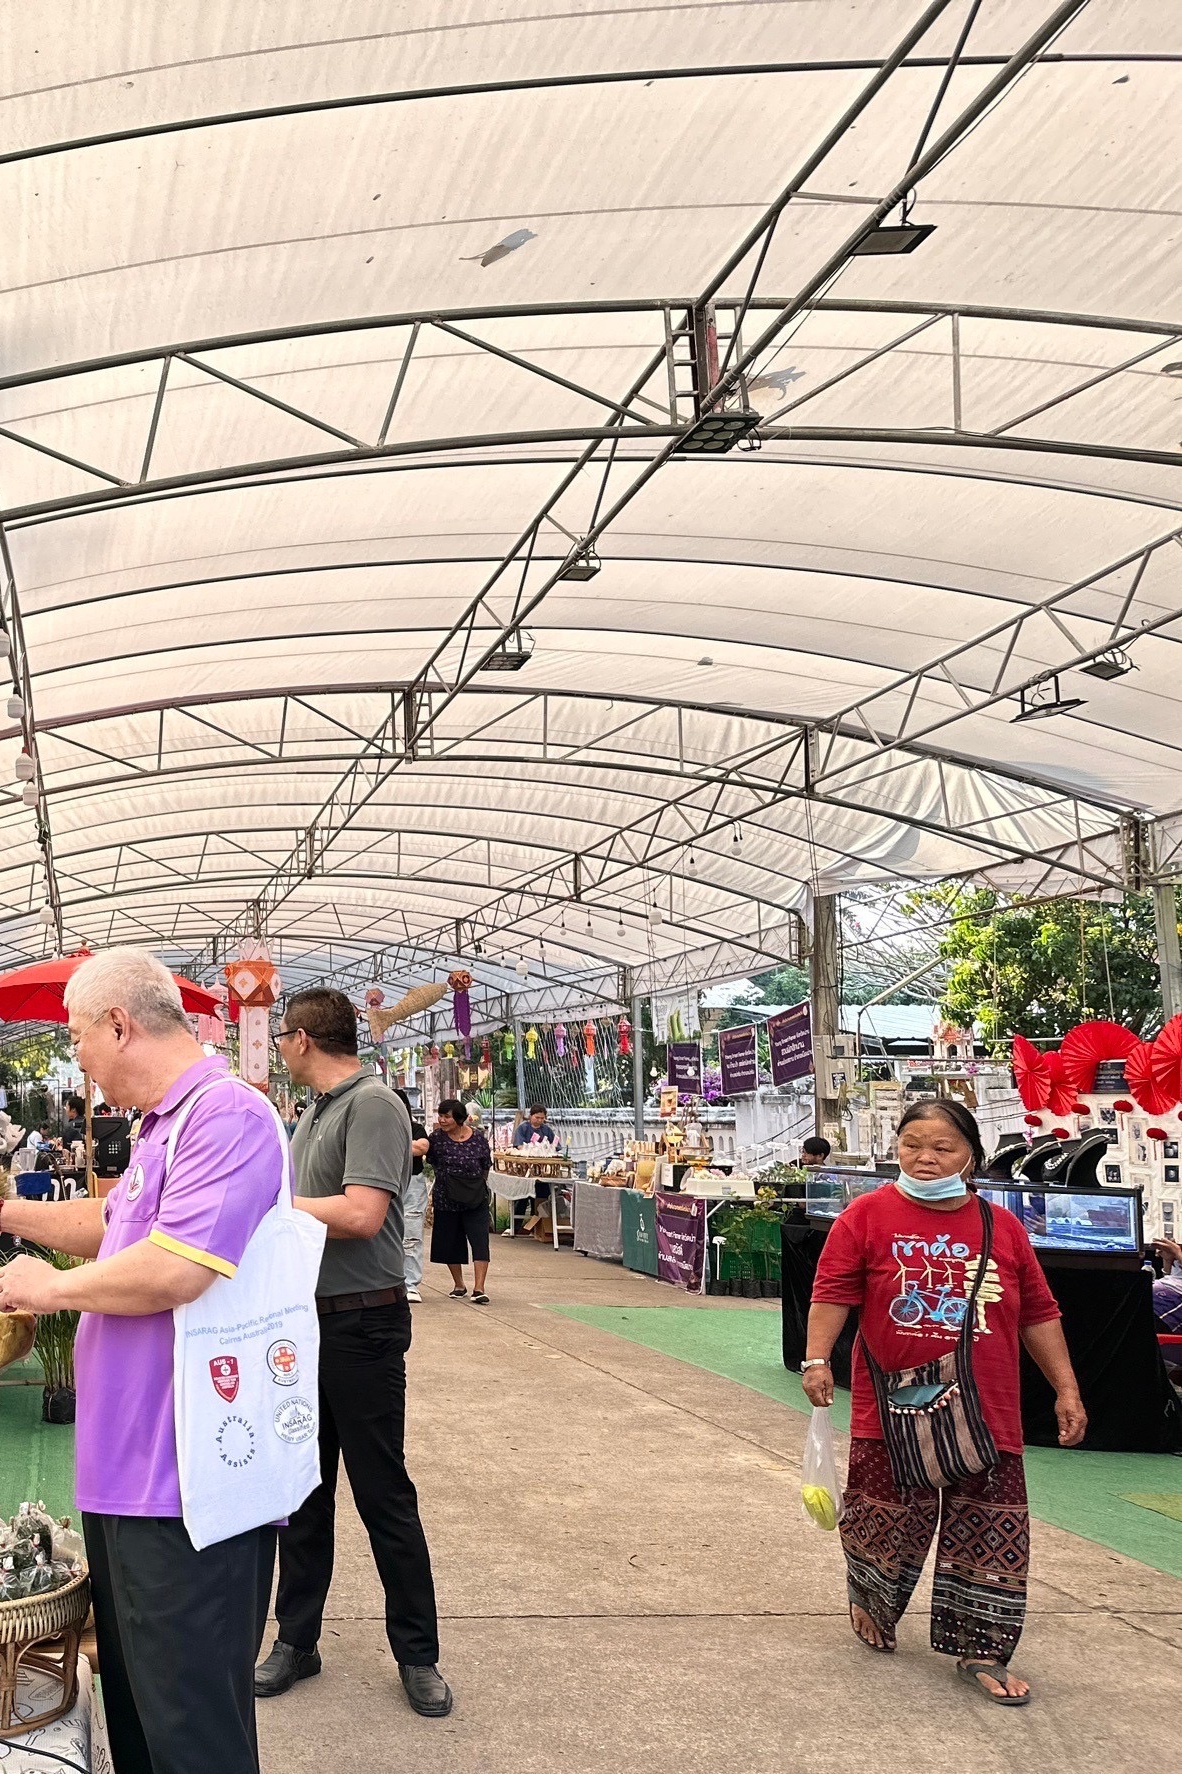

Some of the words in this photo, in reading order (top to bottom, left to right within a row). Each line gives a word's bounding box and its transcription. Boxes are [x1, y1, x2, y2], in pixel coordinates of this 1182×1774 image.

[892, 1234, 970, 1257] เขาค้อ
[185, 1326, 218, 1338] INSARAG
[219, 1320, 258, 1334] Asia-Pacific
[219, 1335, 242, 1345] Cairns
[267, 1321, 283, 1331] 2019
[275, 1401, 291, 1423] UNITED
[291, 1399, 313, 1412] NATIONS
[282, 1414, 313, 1430] INSARAG
[216, 1416, 255, 1443] Australia
[220, 1448, 256, 1468] Assists
